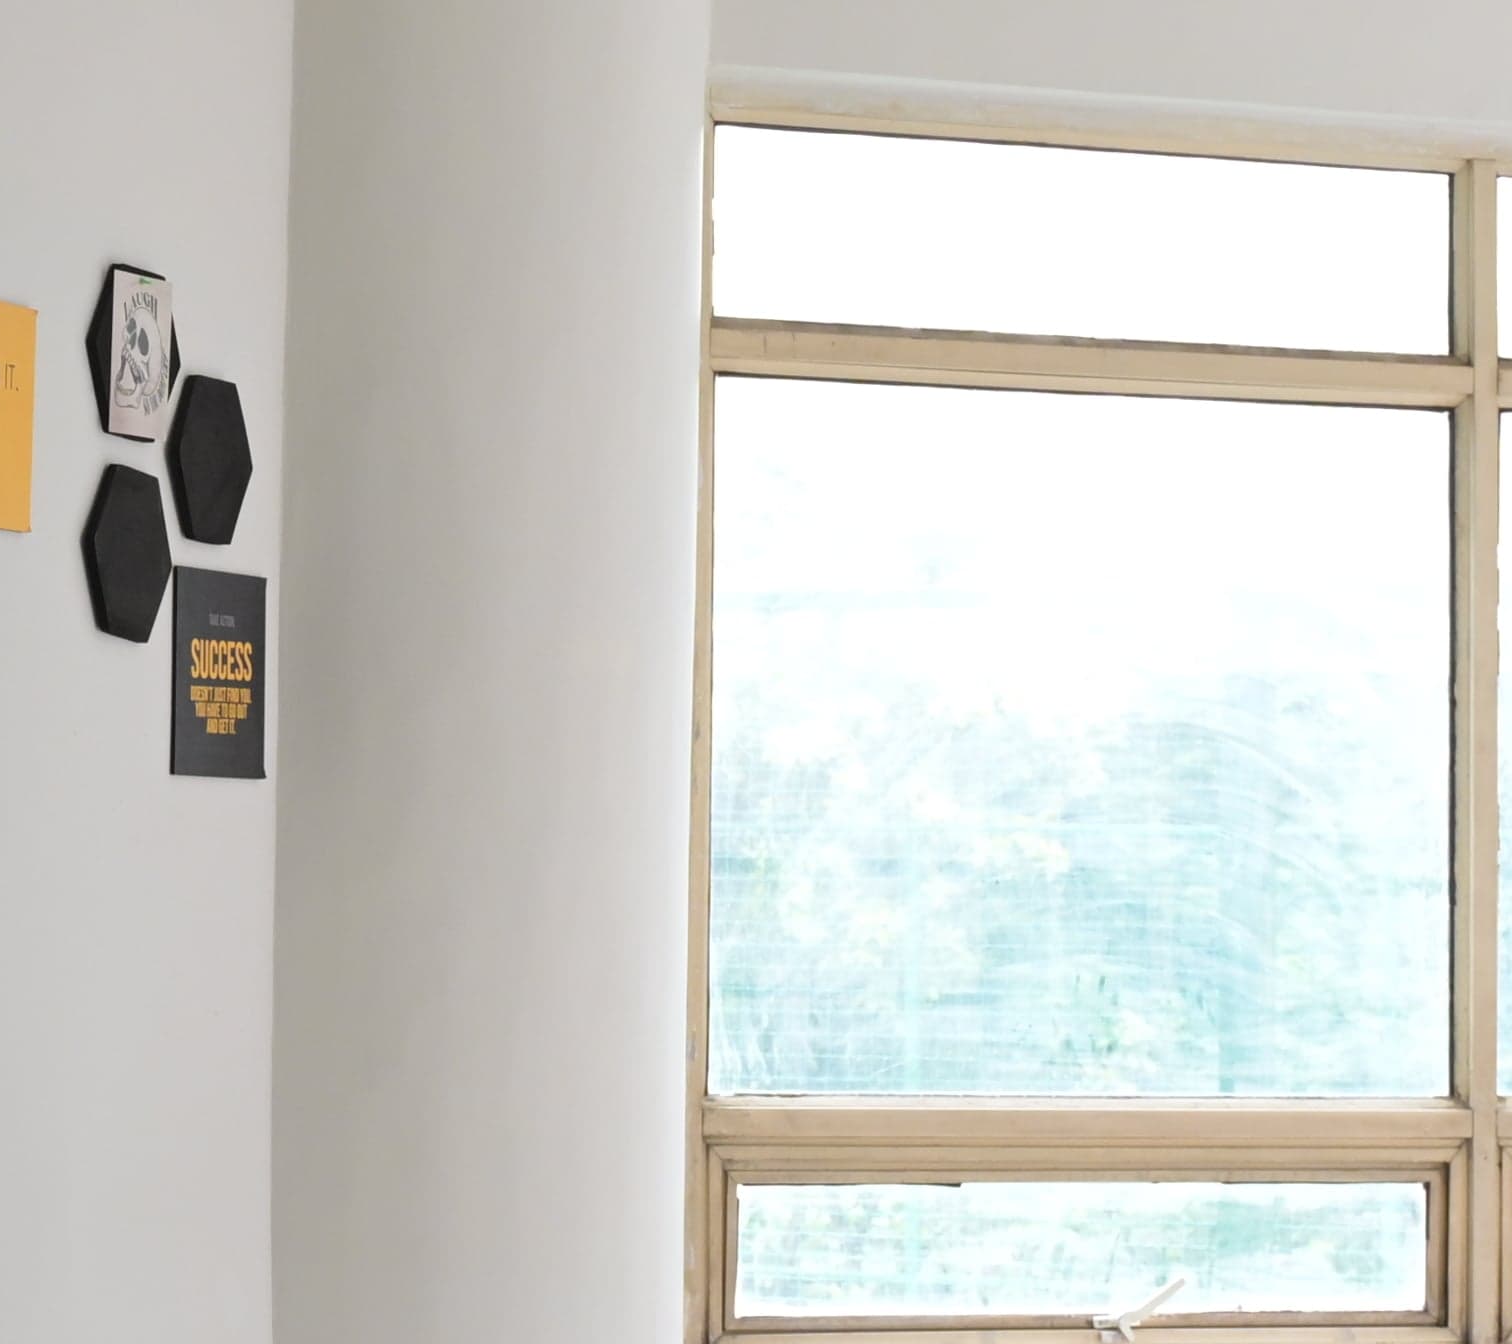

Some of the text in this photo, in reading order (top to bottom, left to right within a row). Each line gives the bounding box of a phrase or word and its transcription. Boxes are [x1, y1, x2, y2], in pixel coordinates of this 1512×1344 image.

[123, 291, 158, 322] LAUGH
[5, 363, 19, 392] IT.
[191, 638, 253, 681] SUCCESS
